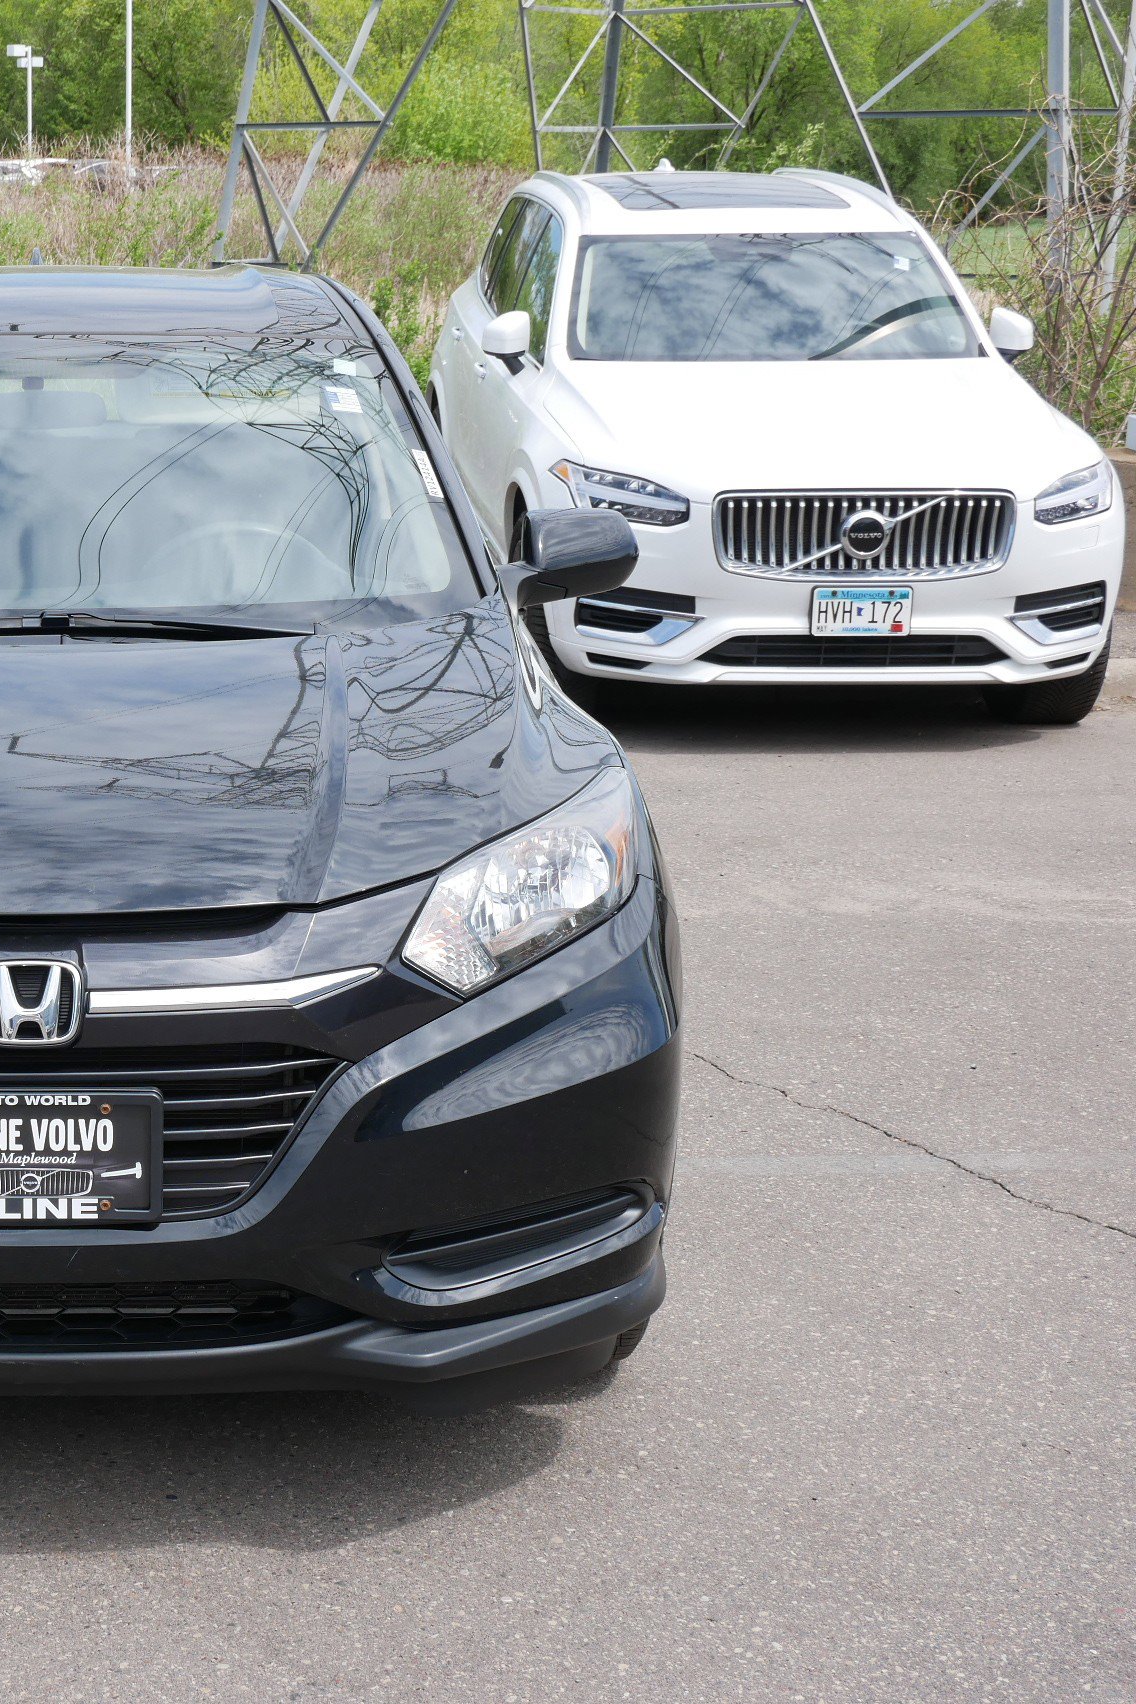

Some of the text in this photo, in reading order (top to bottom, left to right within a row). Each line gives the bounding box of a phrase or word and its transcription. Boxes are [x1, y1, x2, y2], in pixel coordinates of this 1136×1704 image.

[841, 590, 885, 600] Minnesota
[817, 601, 904, 624] HVH 172
[24, 1095, 91, 1106] WORLD
[30, 1118, 114, 1152] VOLVO
[0, 1152, 77, 1167] Maplewood
